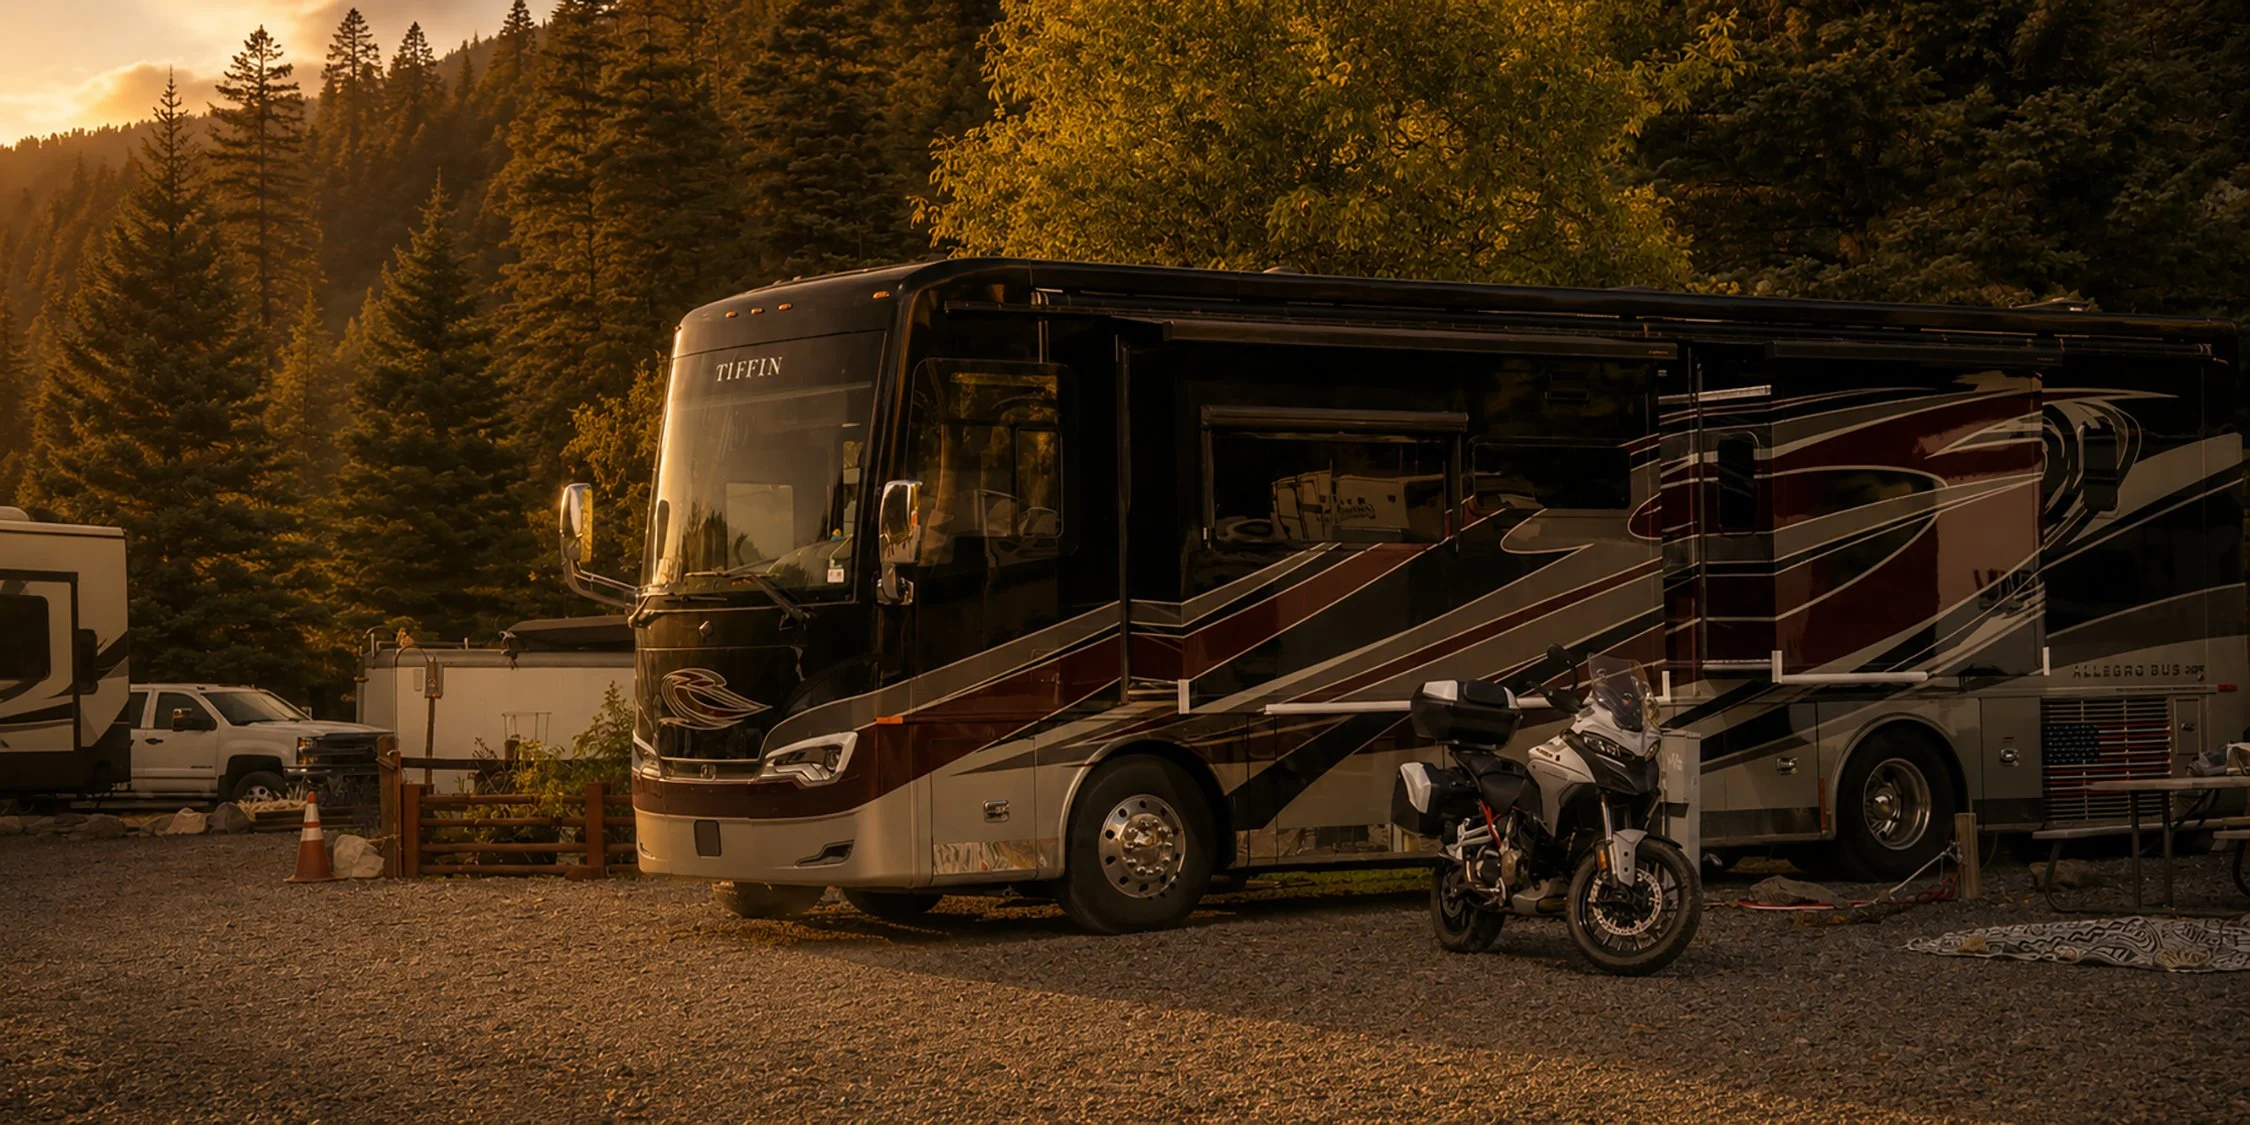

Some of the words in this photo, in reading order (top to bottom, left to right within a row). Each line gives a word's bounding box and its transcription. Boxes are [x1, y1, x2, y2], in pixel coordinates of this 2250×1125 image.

[716, 356, 783, 382] TIFFIN
[2072, 665, 2144, 679] ALLEGRO
[2150, 664, 2181, 676] BUS
